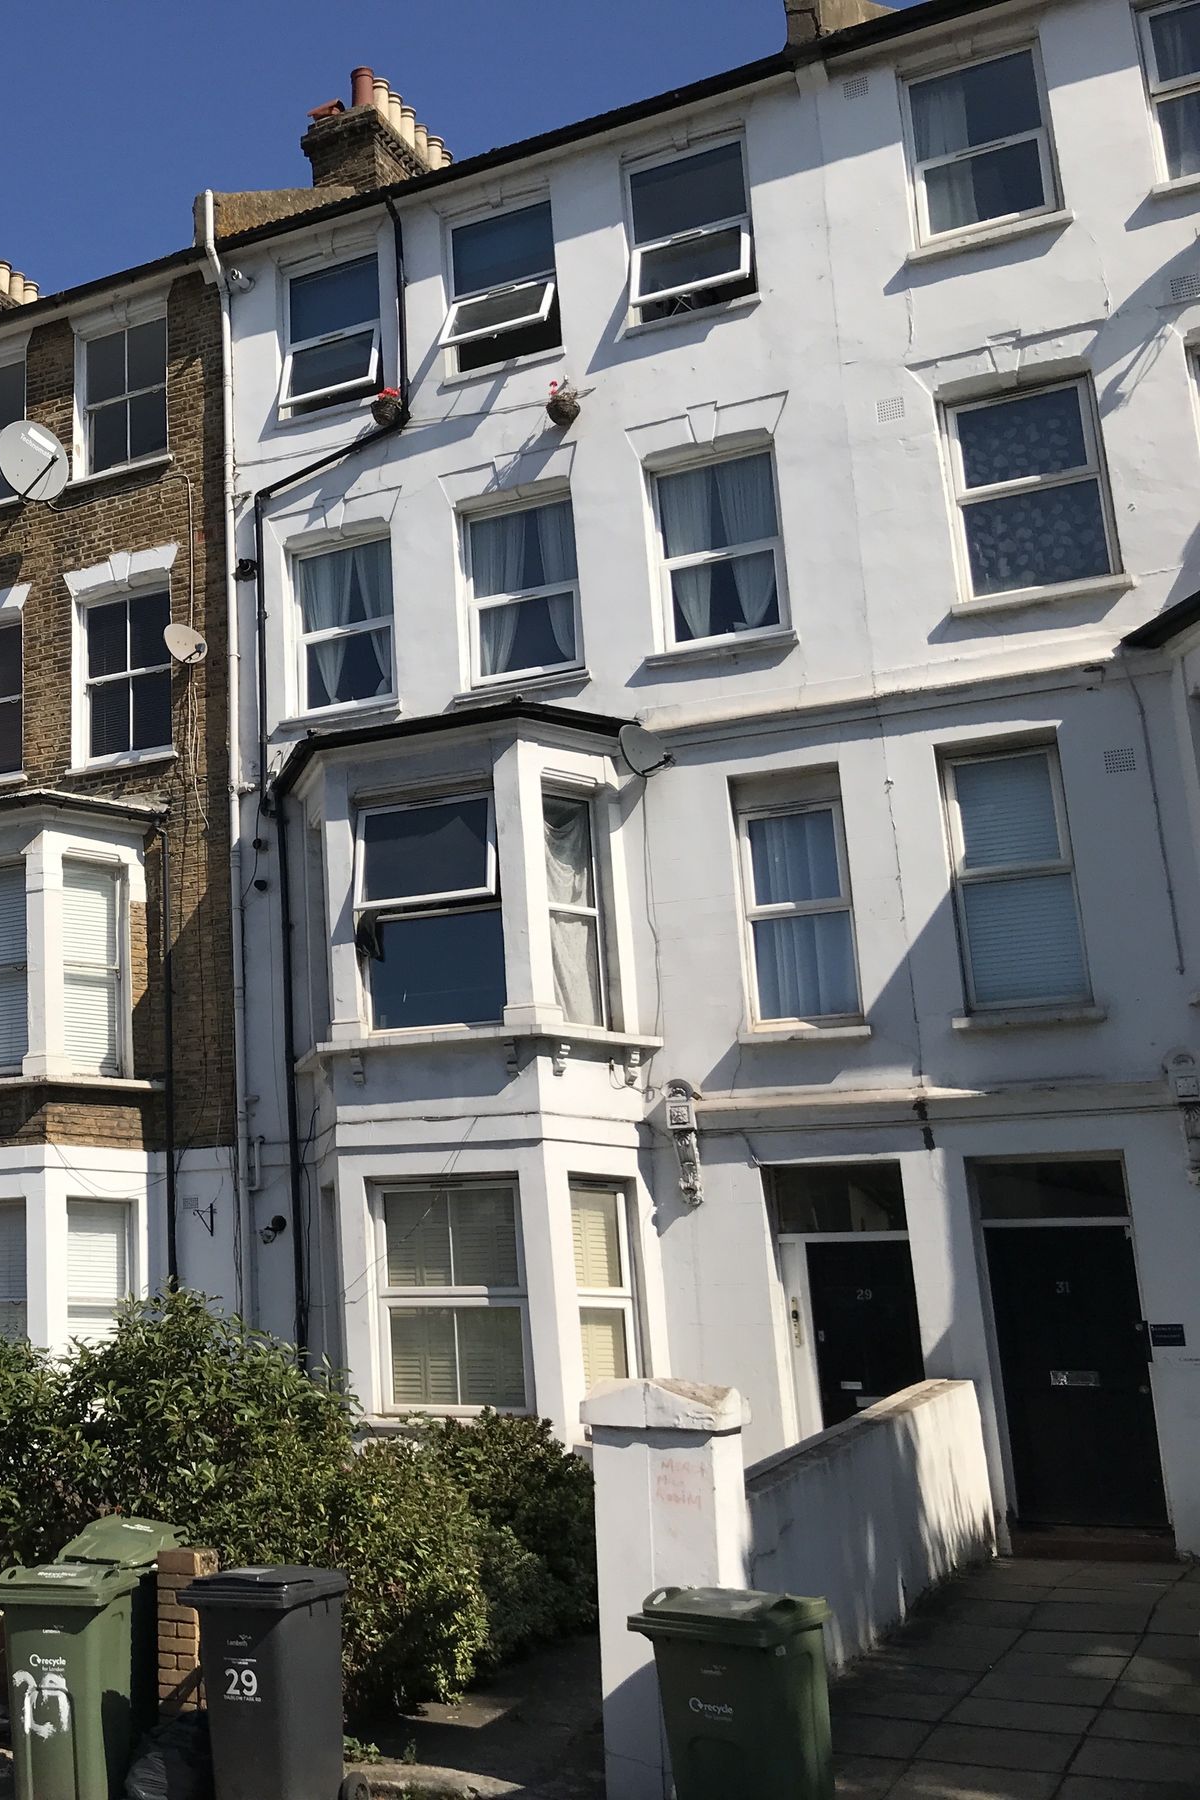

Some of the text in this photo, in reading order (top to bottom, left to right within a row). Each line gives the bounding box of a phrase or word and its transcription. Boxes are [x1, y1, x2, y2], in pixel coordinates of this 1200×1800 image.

[20, 432, 53, 460] Technomat
[856, 1288, 872, 1300] 29
[41, 1656, 67, 1667] recycle
[224, 1668, 258, 1697] 29
[703, 1703, 733, 1715] recycle
